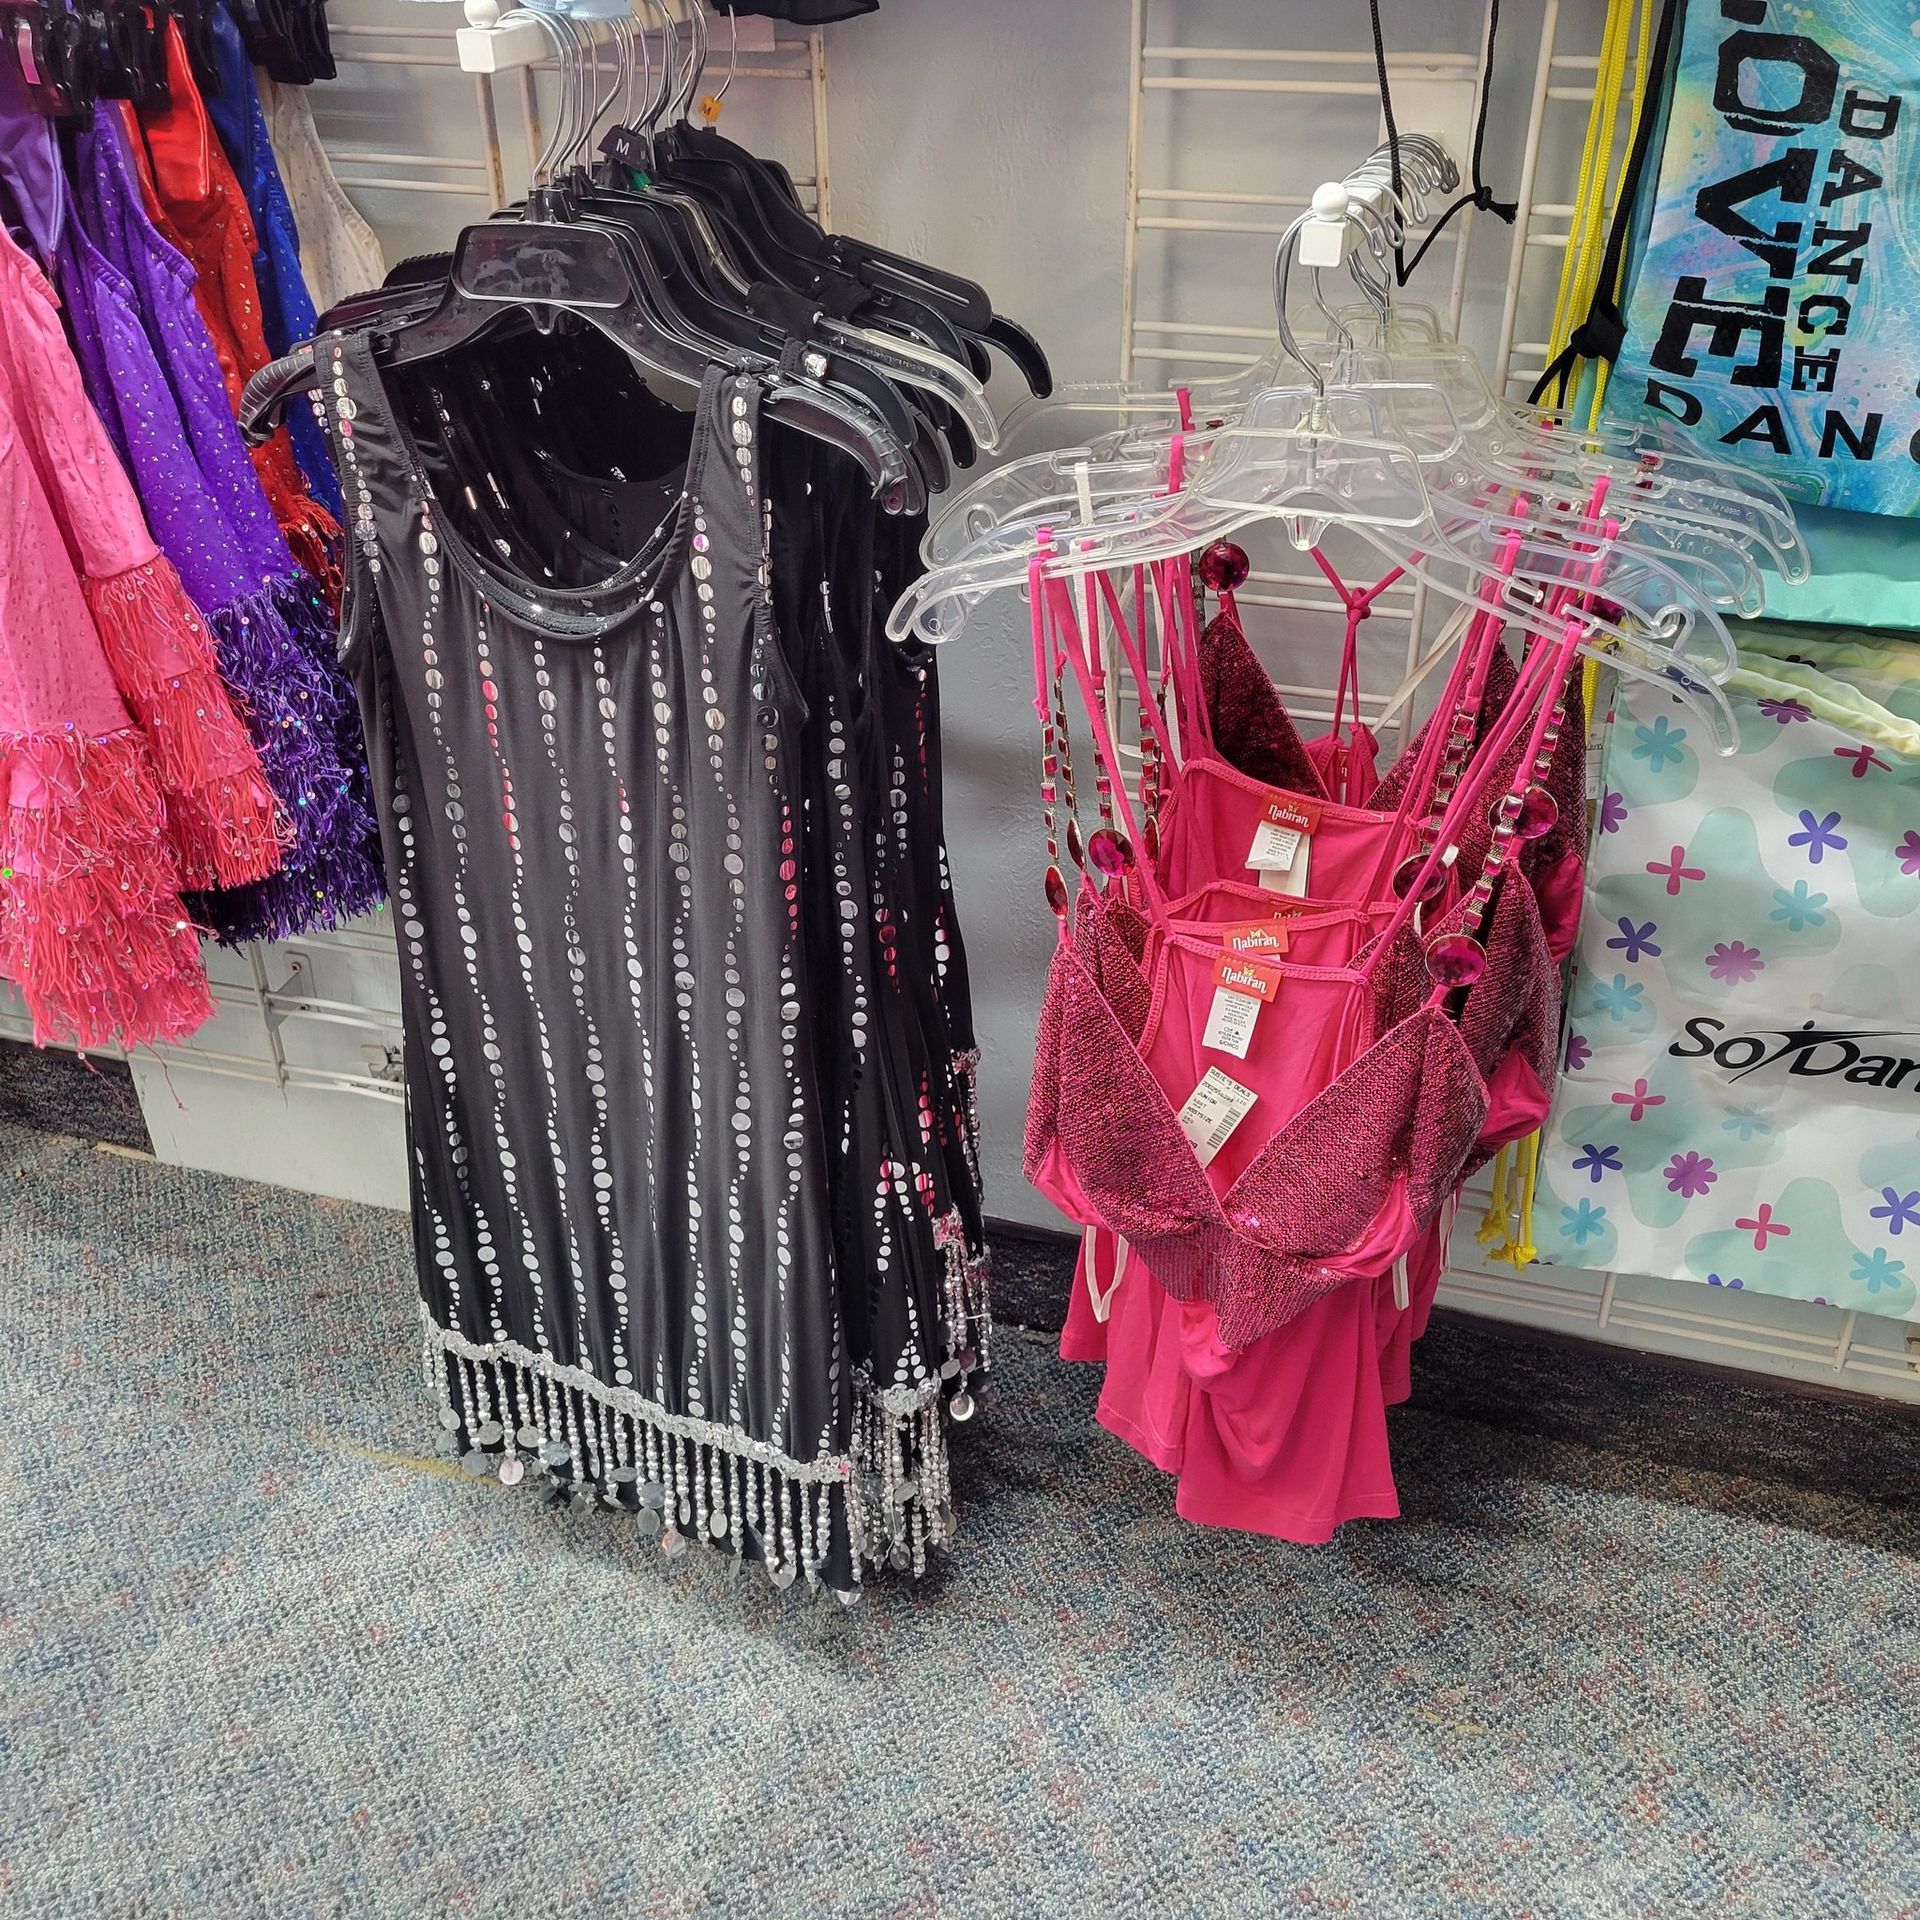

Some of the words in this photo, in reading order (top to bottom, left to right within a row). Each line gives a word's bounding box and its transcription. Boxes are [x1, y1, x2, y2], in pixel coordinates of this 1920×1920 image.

[616, 138, 630, 156] M
[1791, 90, 1902, 392] DANCE
[1643, 377, 1920, 465] DAN
[1210, 1068, 1232, 1086] SUSIE'S
[1234, 1084, 1251, 1098] DEALS
[1197, 1091, 1218, 1106] JUNIOR
